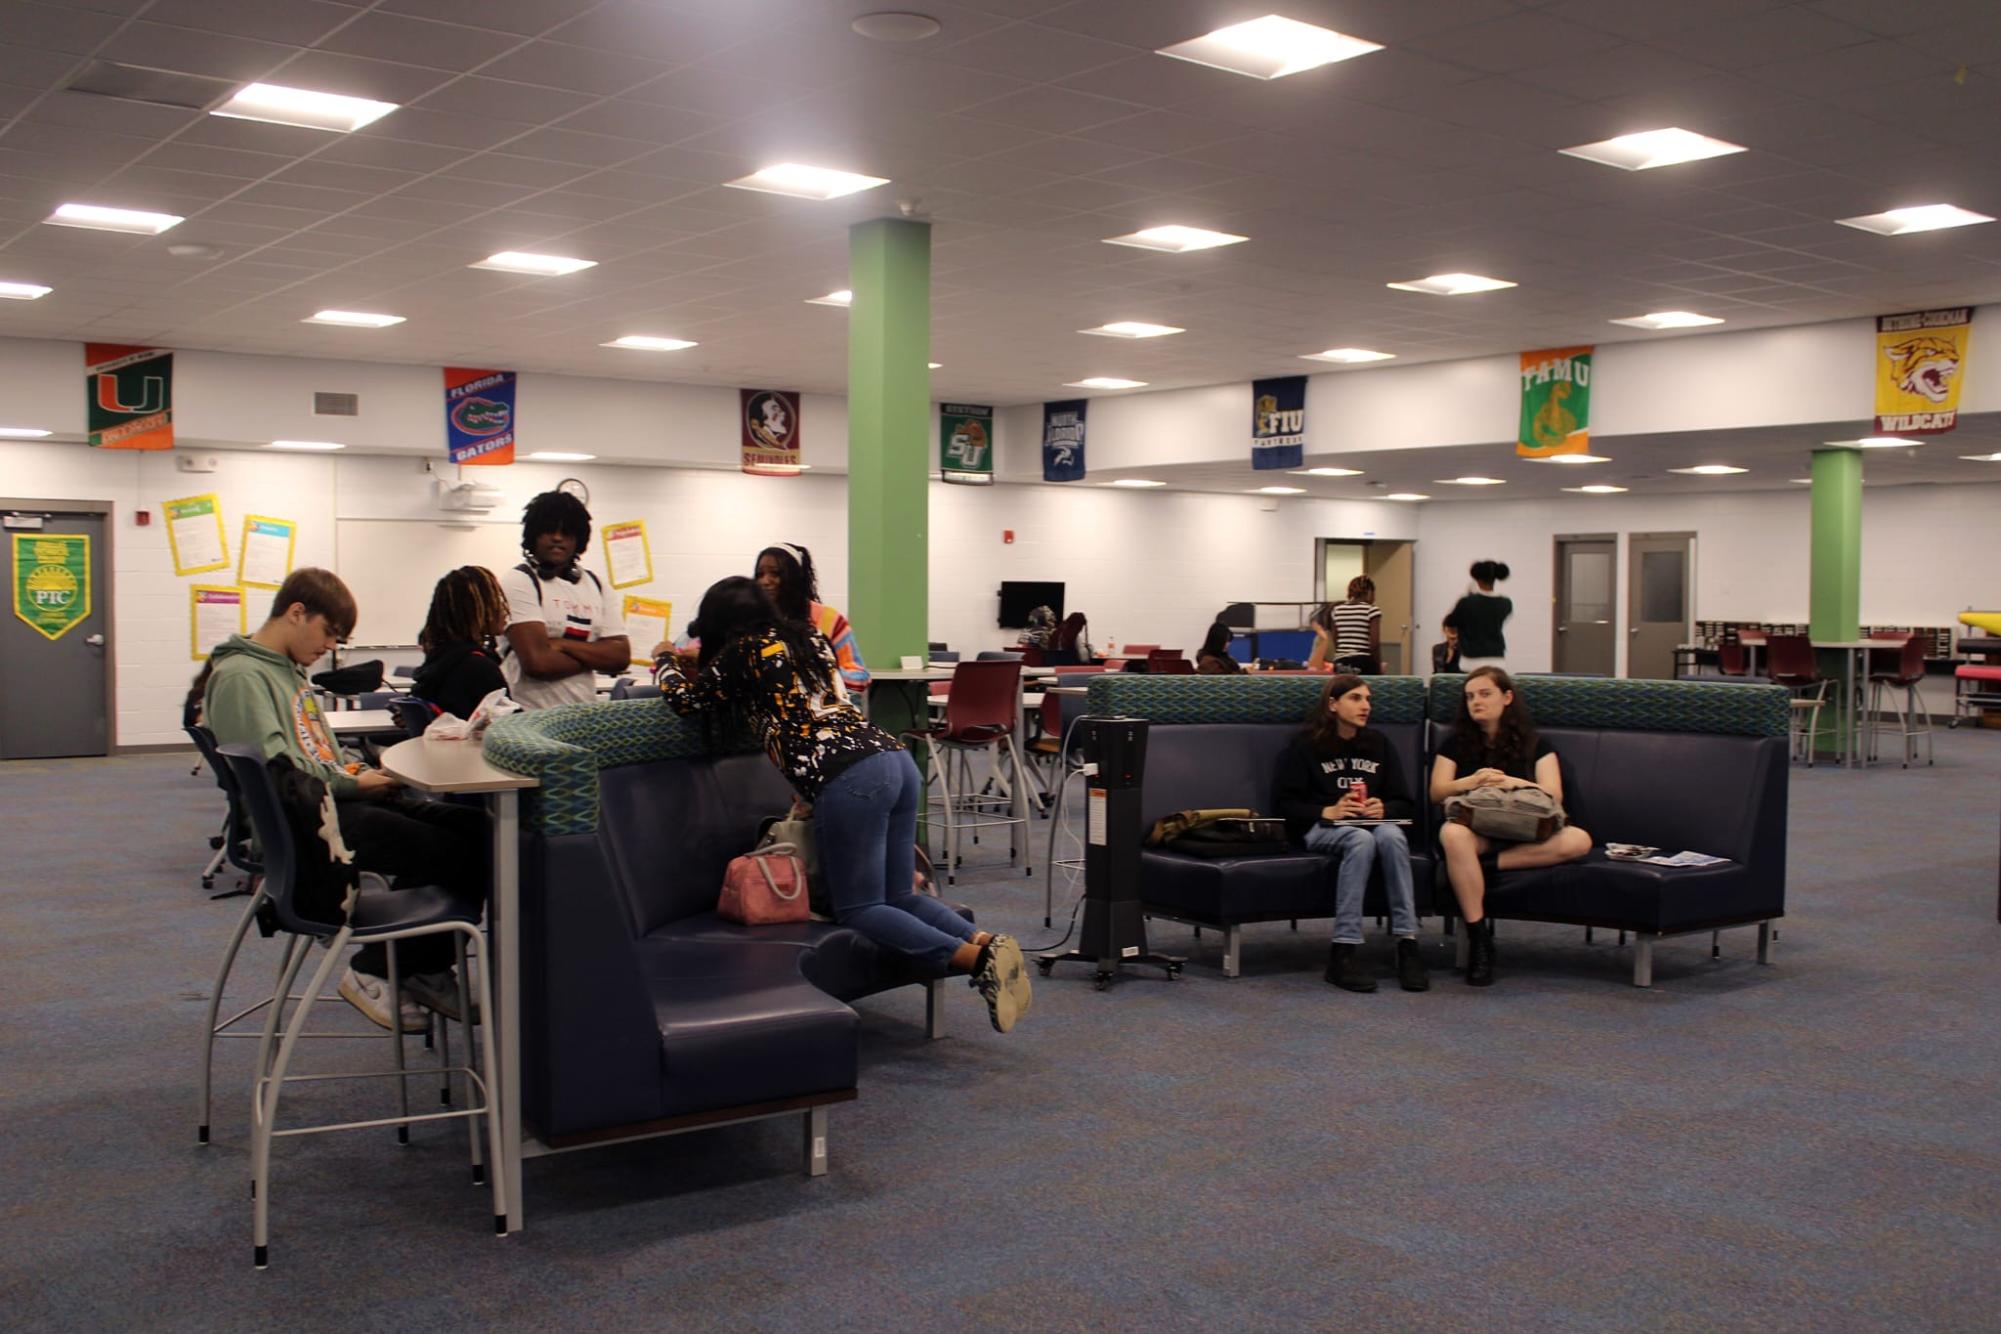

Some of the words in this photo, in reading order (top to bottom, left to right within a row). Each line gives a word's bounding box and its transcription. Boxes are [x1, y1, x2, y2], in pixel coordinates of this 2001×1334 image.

[97, 373, 164, 414] U
[450, 374, 504, 398] FLORIDA
[1269, 409, 1304, 434] FIU
[1880, 410, 1956, 432] WILDCATS
[456, 433, 513, 461] GATORS
[35, 590, 71, 605] PTC
[1320, 758, 1348, 774] NEW
[1351, 758, 1380, 774] YORK
